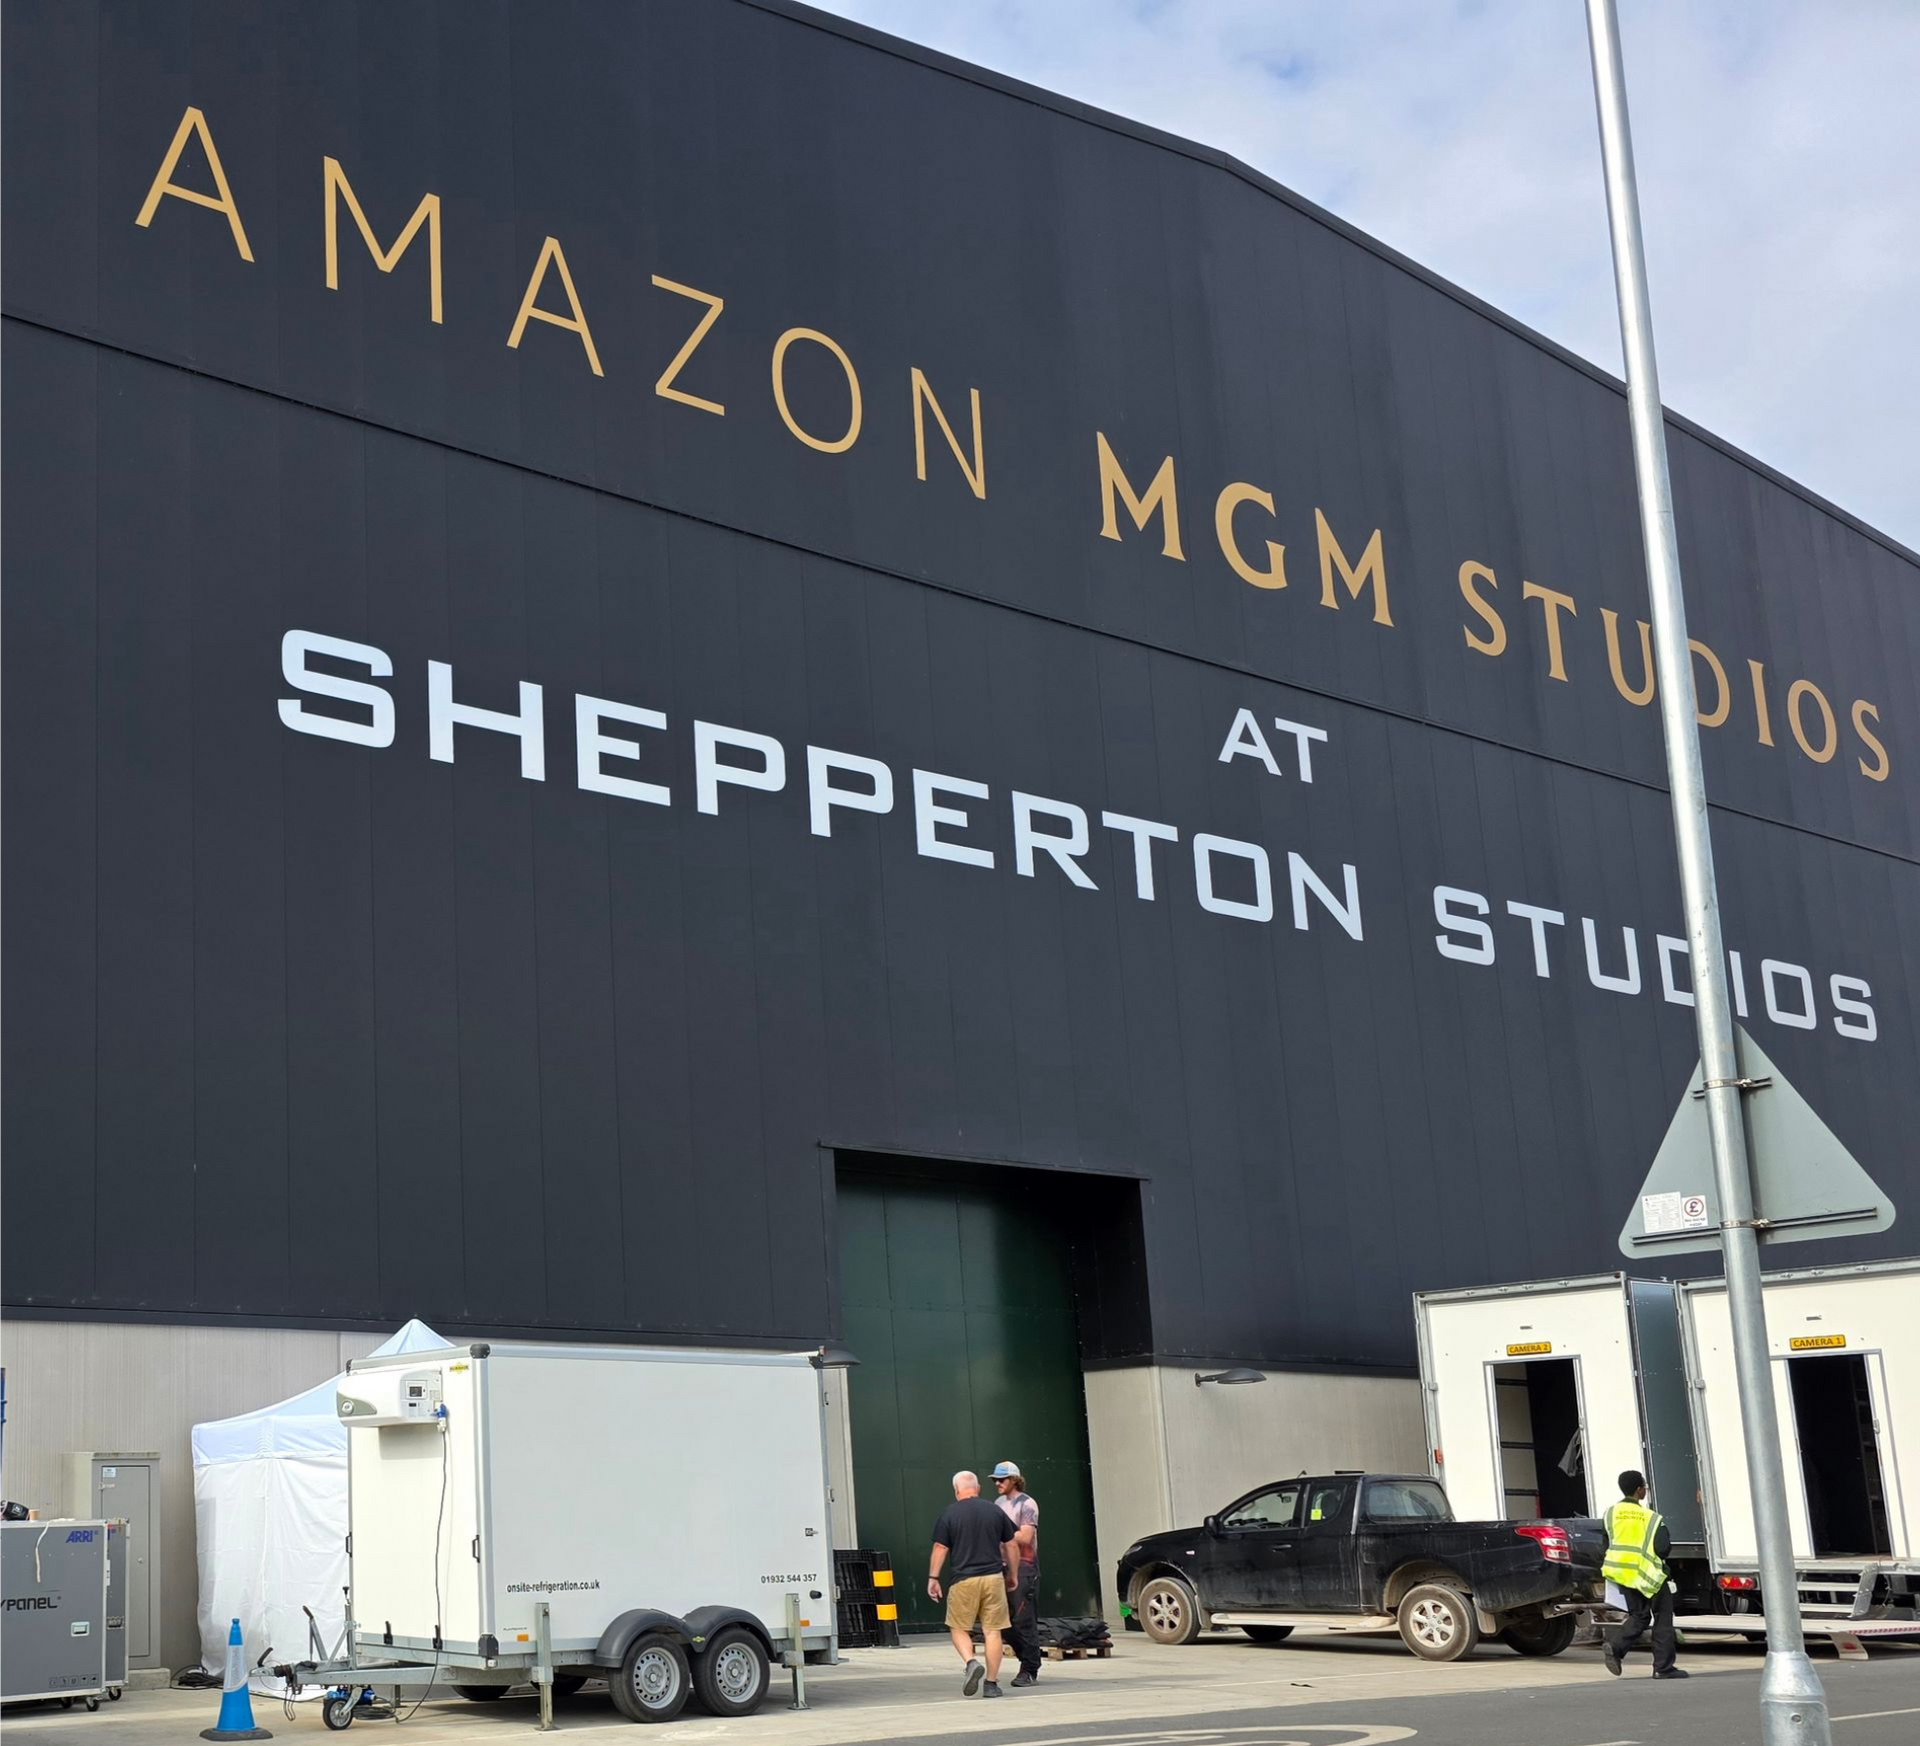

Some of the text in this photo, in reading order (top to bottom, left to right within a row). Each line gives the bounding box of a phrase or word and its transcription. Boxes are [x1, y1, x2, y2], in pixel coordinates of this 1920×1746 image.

[136, 106, 1890, 781] AMAZON MGM STUDIOS
[1218, 707, 1328, 783] AT
[277, 629, 1878, 1042] SHEPPERTON STUDIOS
[1509, 1344, 1542, 1353] CAMERA
[1792, 1337, 1843, 1348] CAMERA 1
[65, 1530, 94, 1543] ARRI
[760, 1573, 817, 1584] 01932 544 357
[506, 1579, 600, 1594] onsite-refrigeration.co.uk
